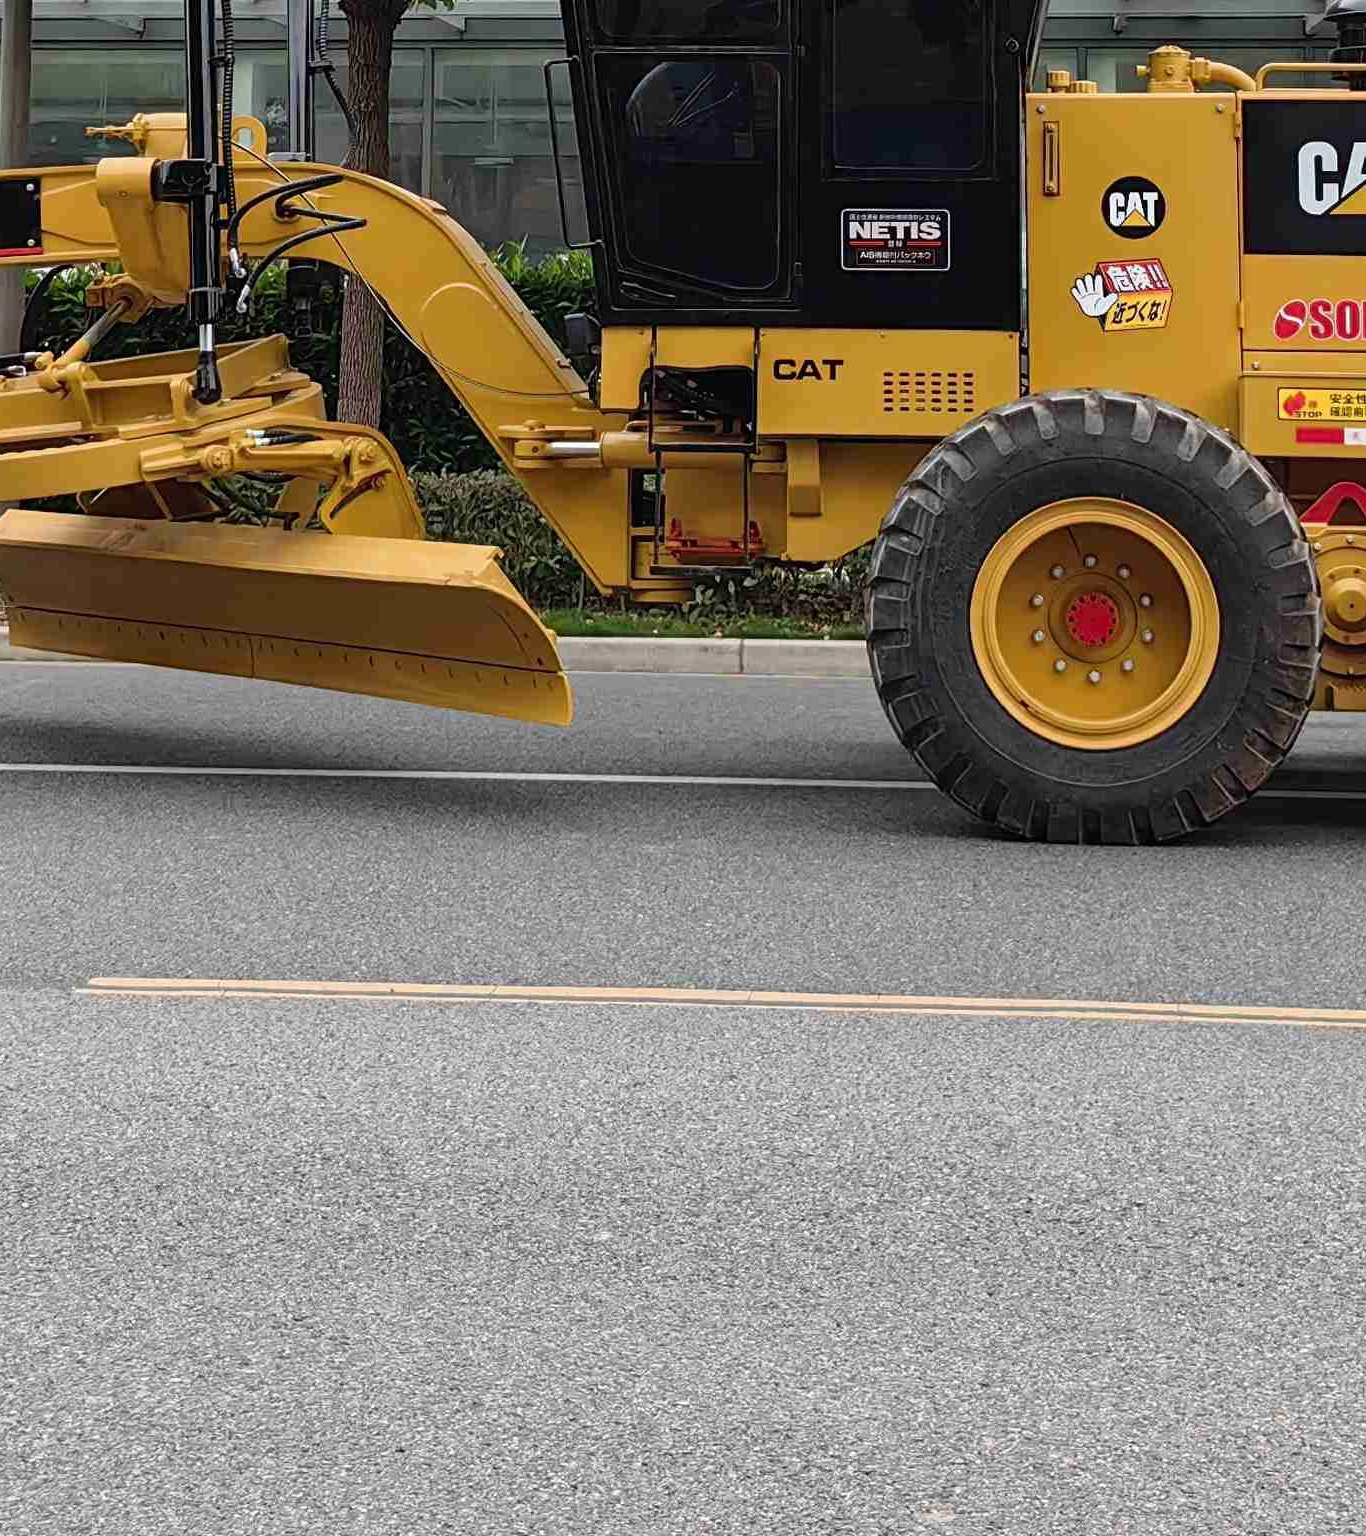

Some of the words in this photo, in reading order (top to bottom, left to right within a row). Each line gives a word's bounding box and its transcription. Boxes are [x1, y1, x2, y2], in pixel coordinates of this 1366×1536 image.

[1109, 191, 1159, 227] CAT
[849, 221, 941, 239] NETIS
[773, 359, 844, 381] CAT
